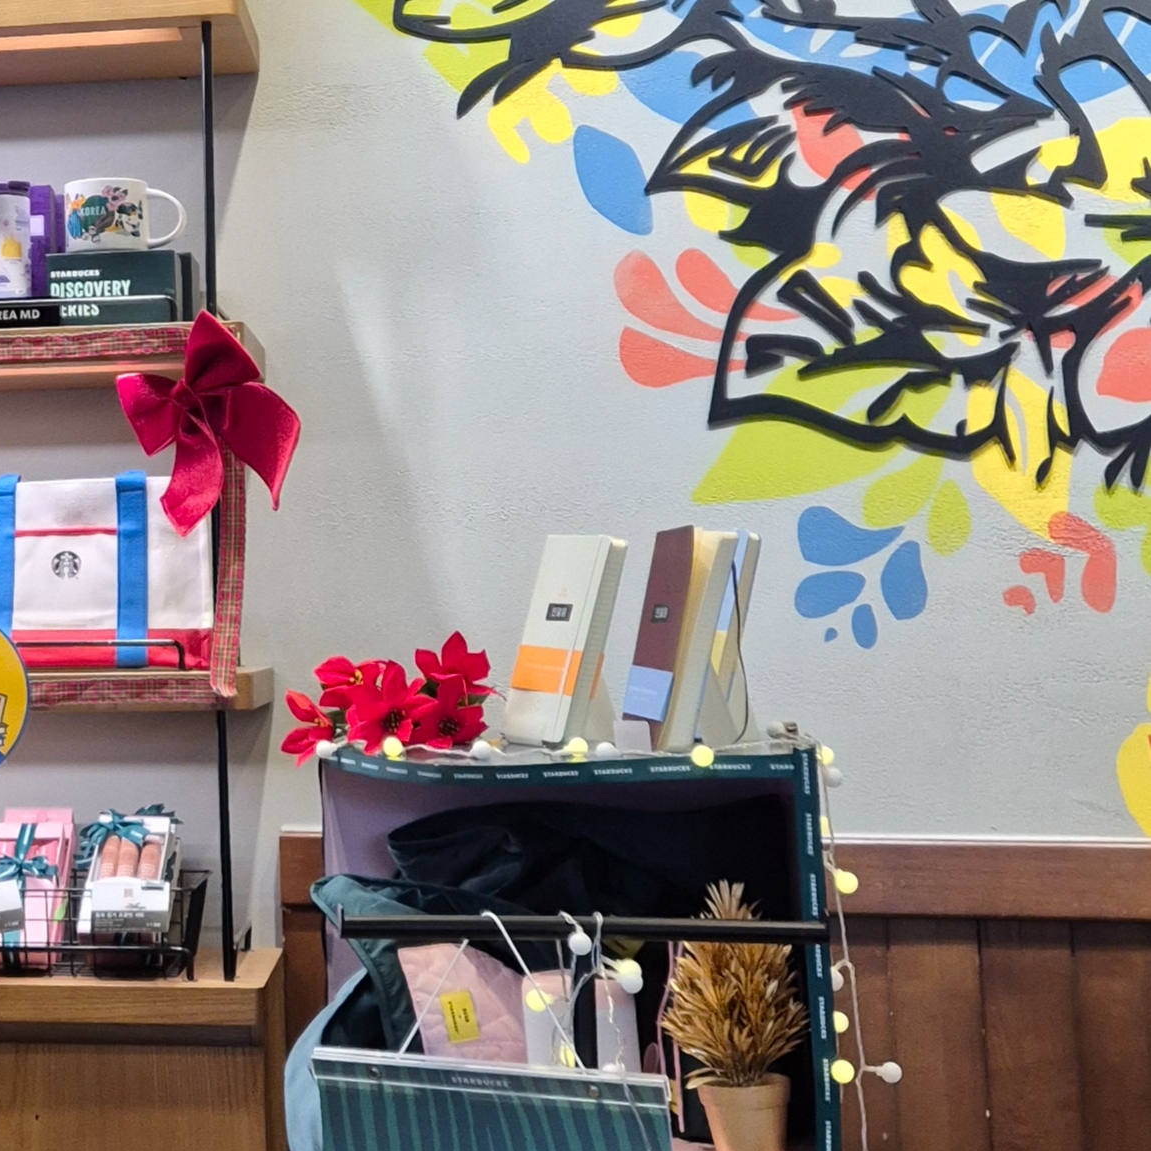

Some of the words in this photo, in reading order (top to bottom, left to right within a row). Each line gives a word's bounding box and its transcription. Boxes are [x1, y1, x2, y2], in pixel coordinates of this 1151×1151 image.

[80, 206, 108, 216] KOREA
[50, 269, 101, 278] STARBUCKS
[50, 279, 131, 298] DISCOVERY
[20, 309, 41, 319] MD
[59, 304, 100, 317] ERIES
[451, 1076, 510, 1088] STARBUCKS
